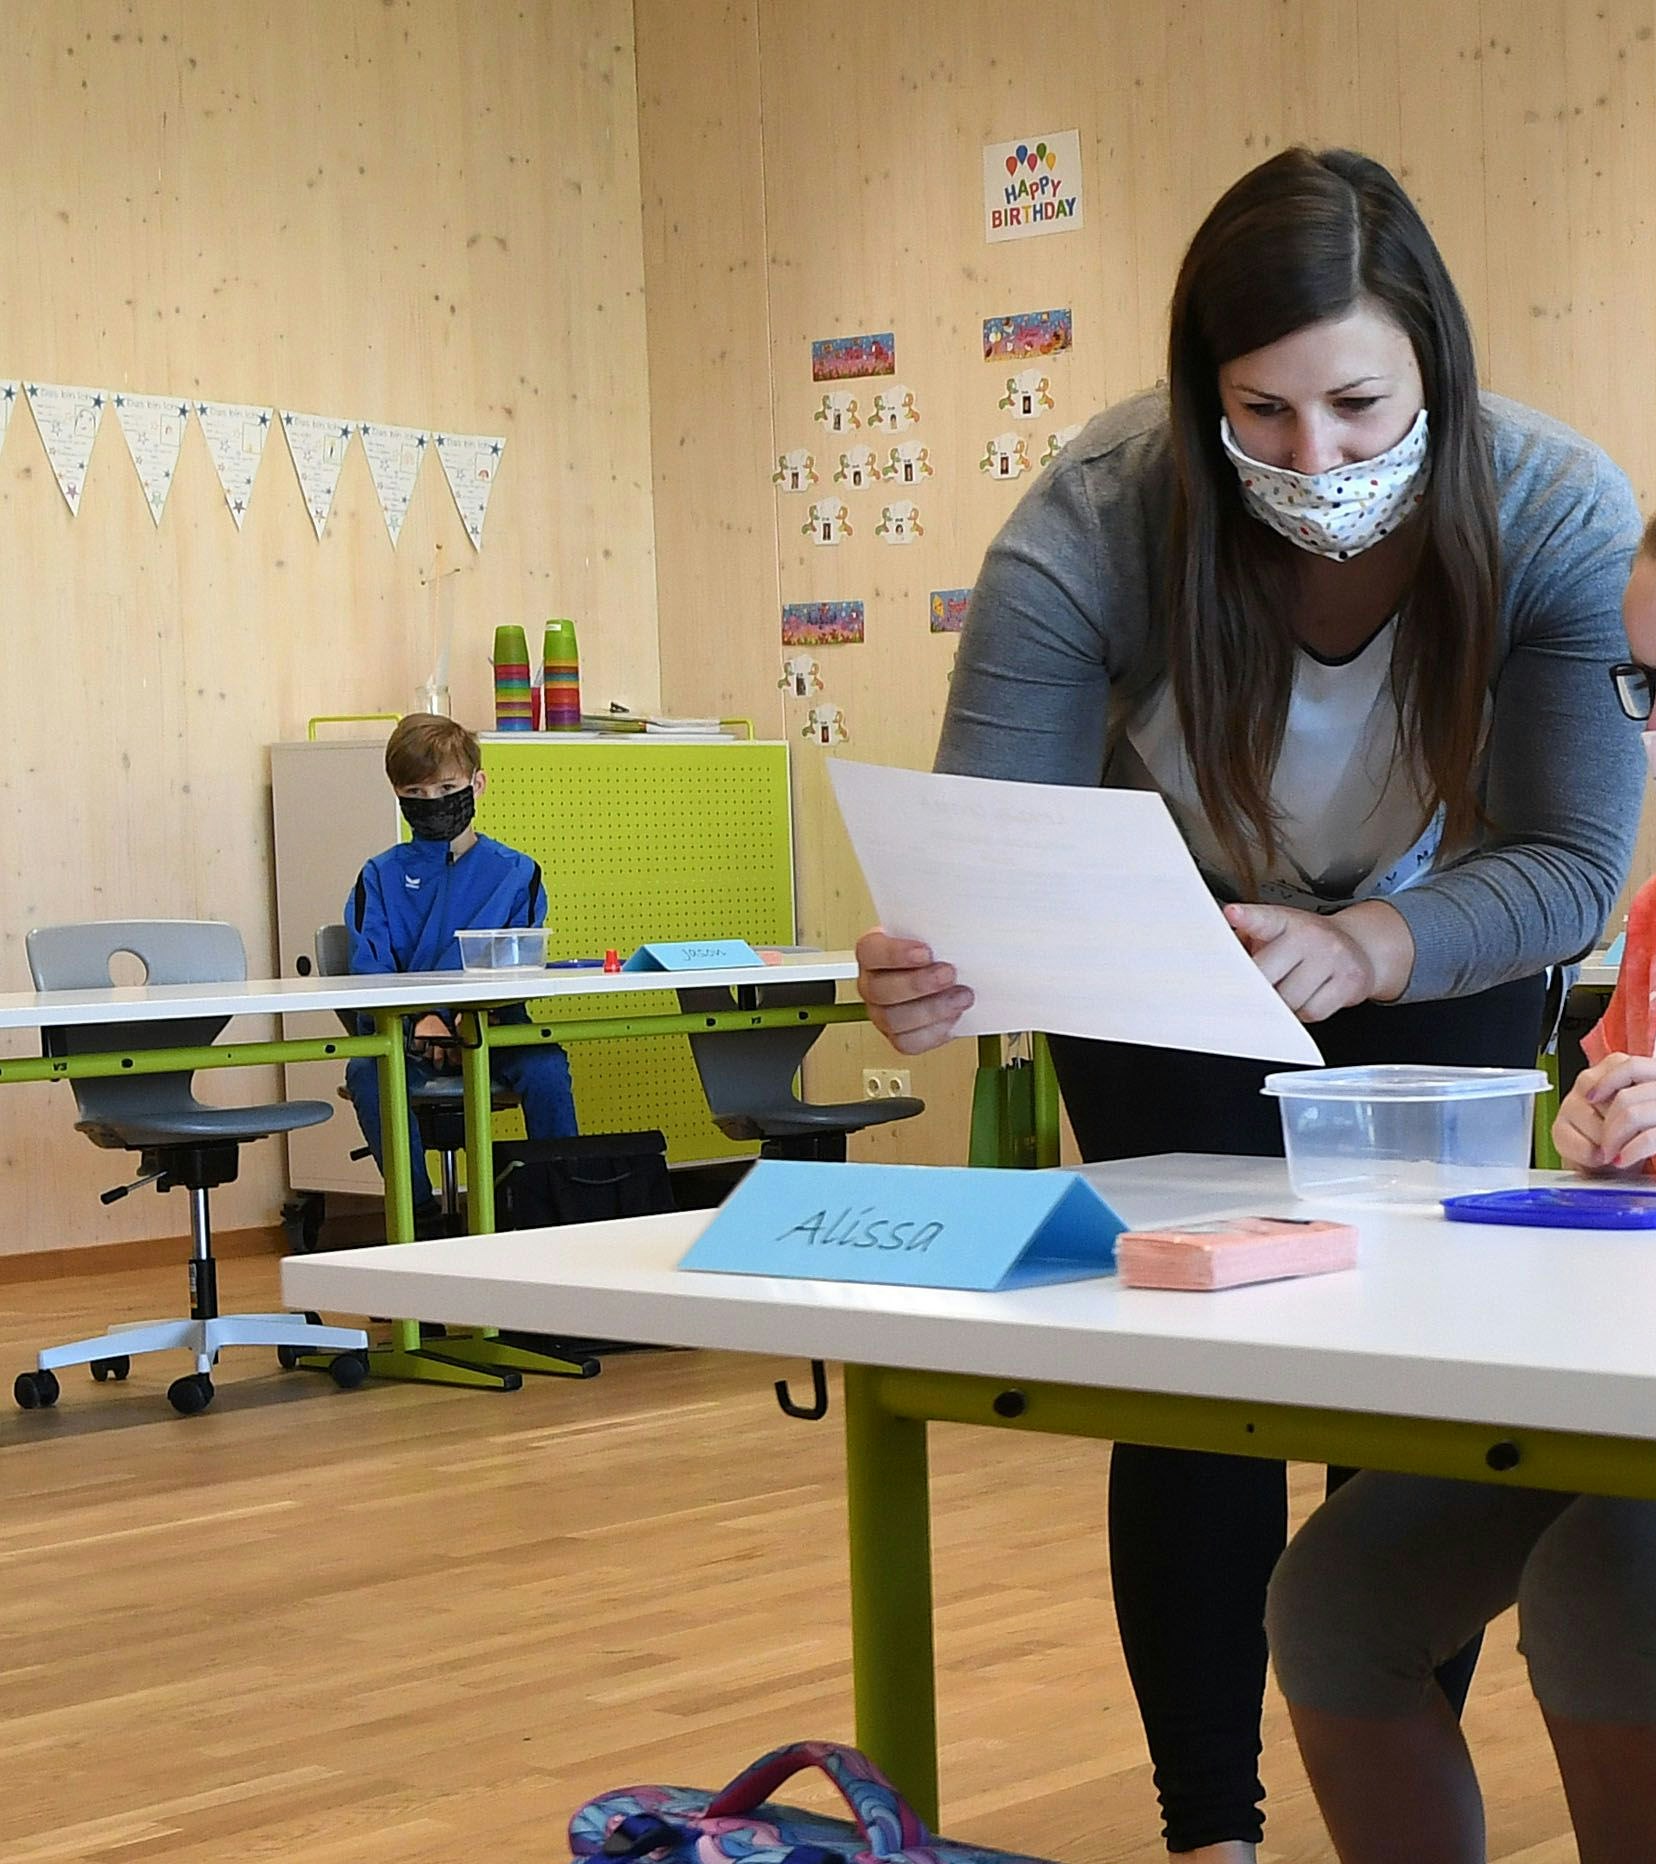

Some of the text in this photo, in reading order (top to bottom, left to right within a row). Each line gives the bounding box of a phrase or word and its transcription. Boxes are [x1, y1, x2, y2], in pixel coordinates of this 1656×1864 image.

[1004, 175, 1062, 205] HAPPY
[992, 196, 1077, 229] BIRTHDAY
[775, 1206, 945, 1252] Alissa
